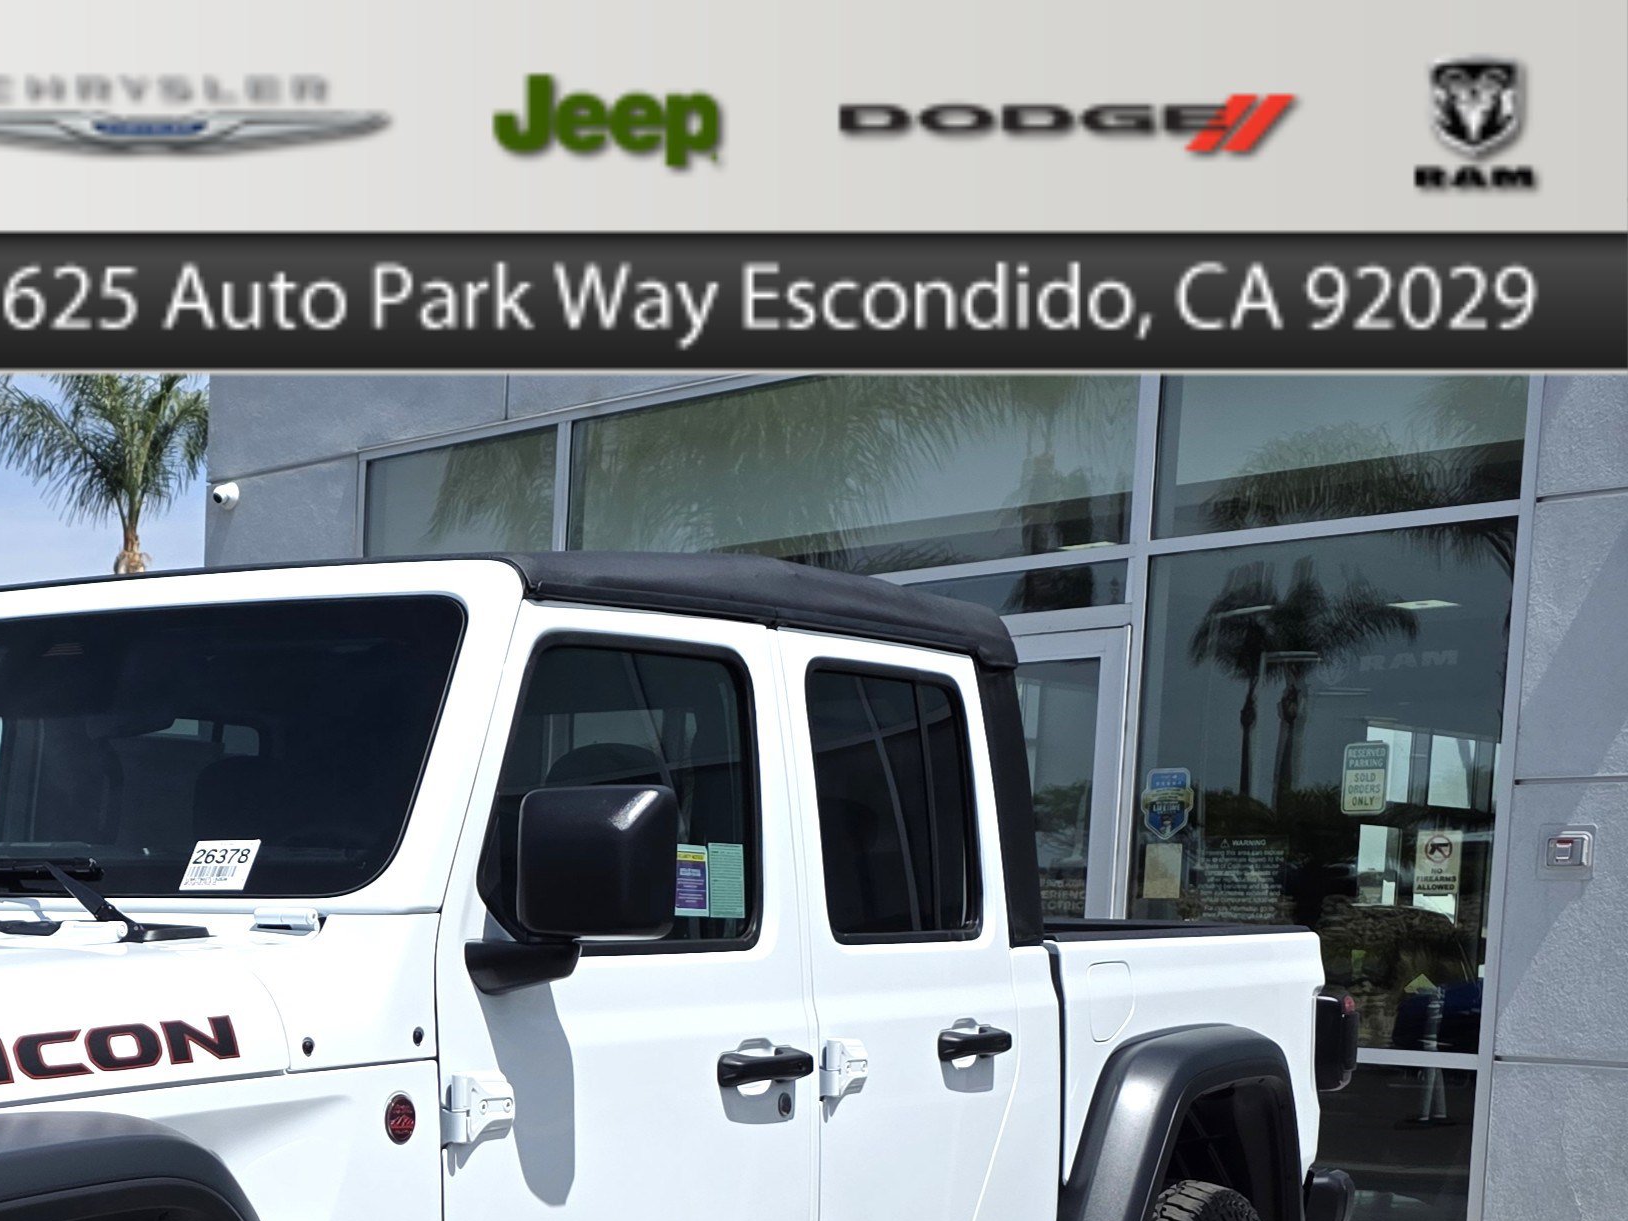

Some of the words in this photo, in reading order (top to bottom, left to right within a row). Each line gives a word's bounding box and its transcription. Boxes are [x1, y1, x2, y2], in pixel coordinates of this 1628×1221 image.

[1358, 649, 1459, 672] RAM
[1348, 747, 1386, 758] RESERVED
[1348, 758, 1384, 768] PARKING
[1354, 772, 1377, 783] SOLD
[1348, 783, 1381, 795] ORDERS
[1351, 796, 1376, 807] ONLY
[191, 848, 251, 865] 26378
